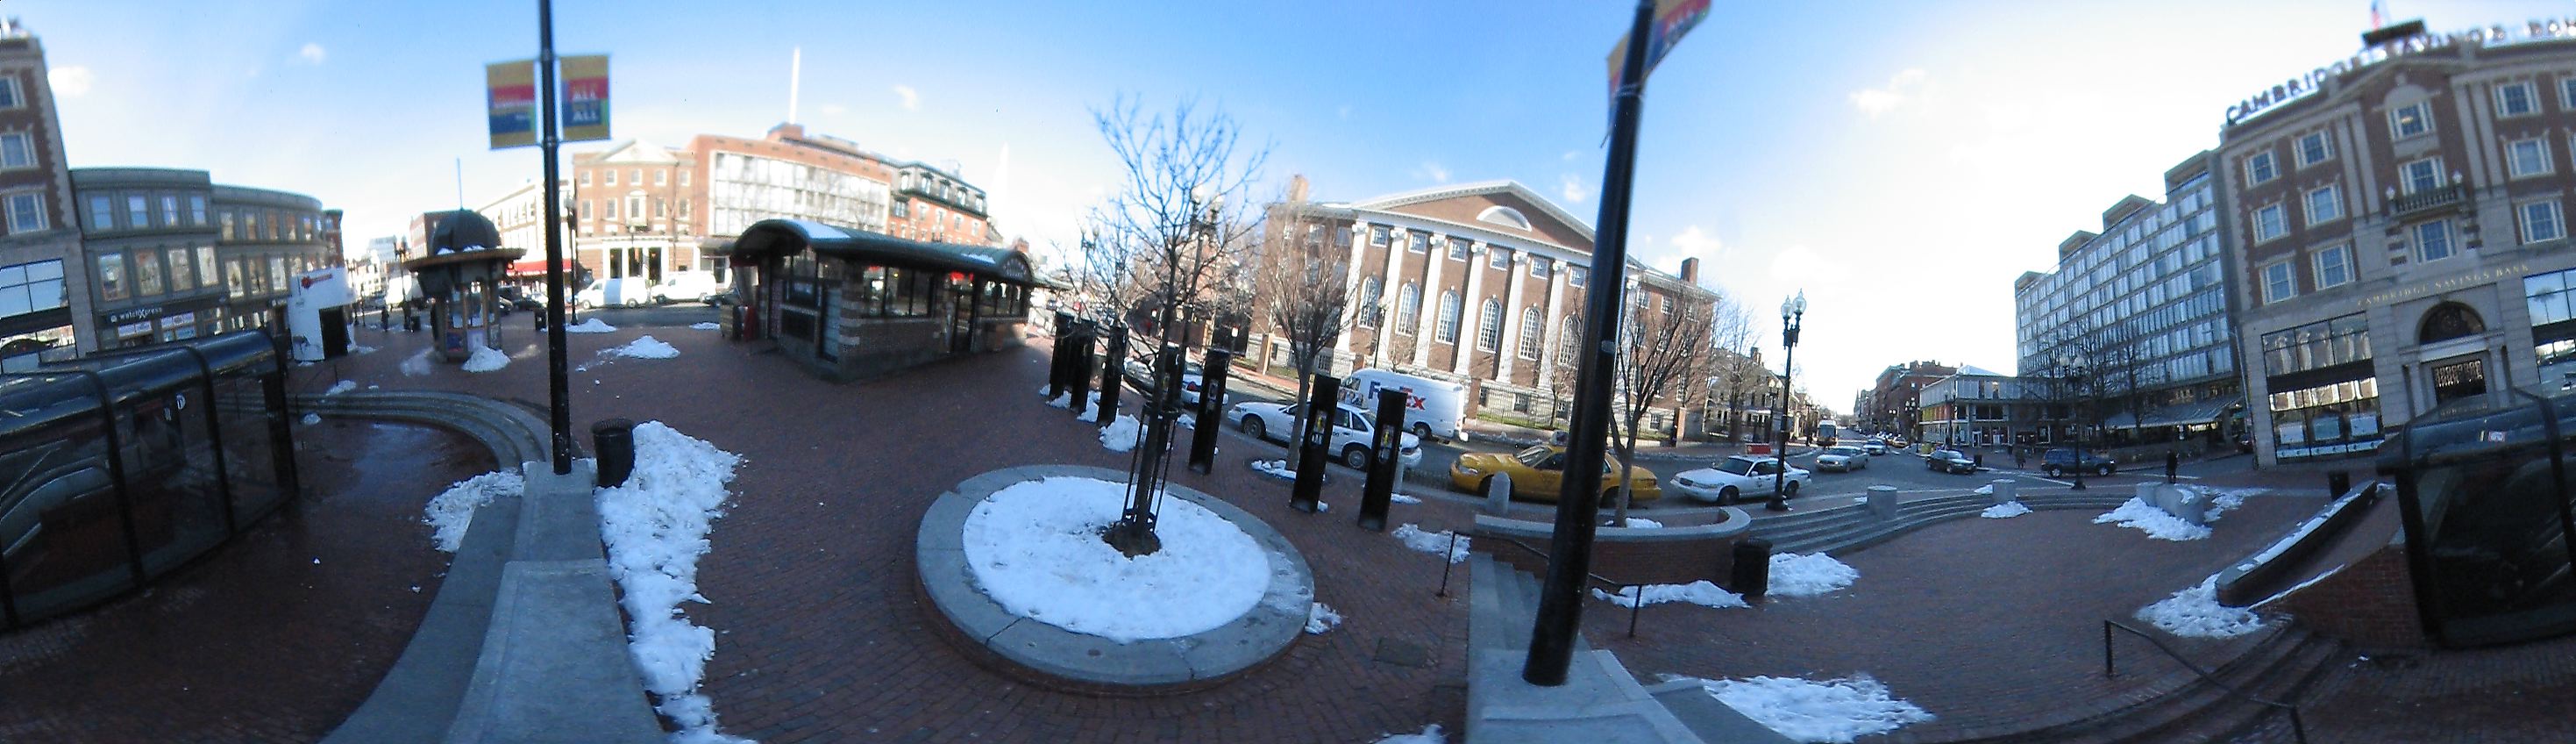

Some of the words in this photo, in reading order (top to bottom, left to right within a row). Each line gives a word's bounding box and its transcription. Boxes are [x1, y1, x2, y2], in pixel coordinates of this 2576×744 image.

[2358, 286, 2429, 306] CAMBRIDGE
[2435, 272, 2489, 290] SAVINGS
[2496, 265, 2530, 277] BANK
